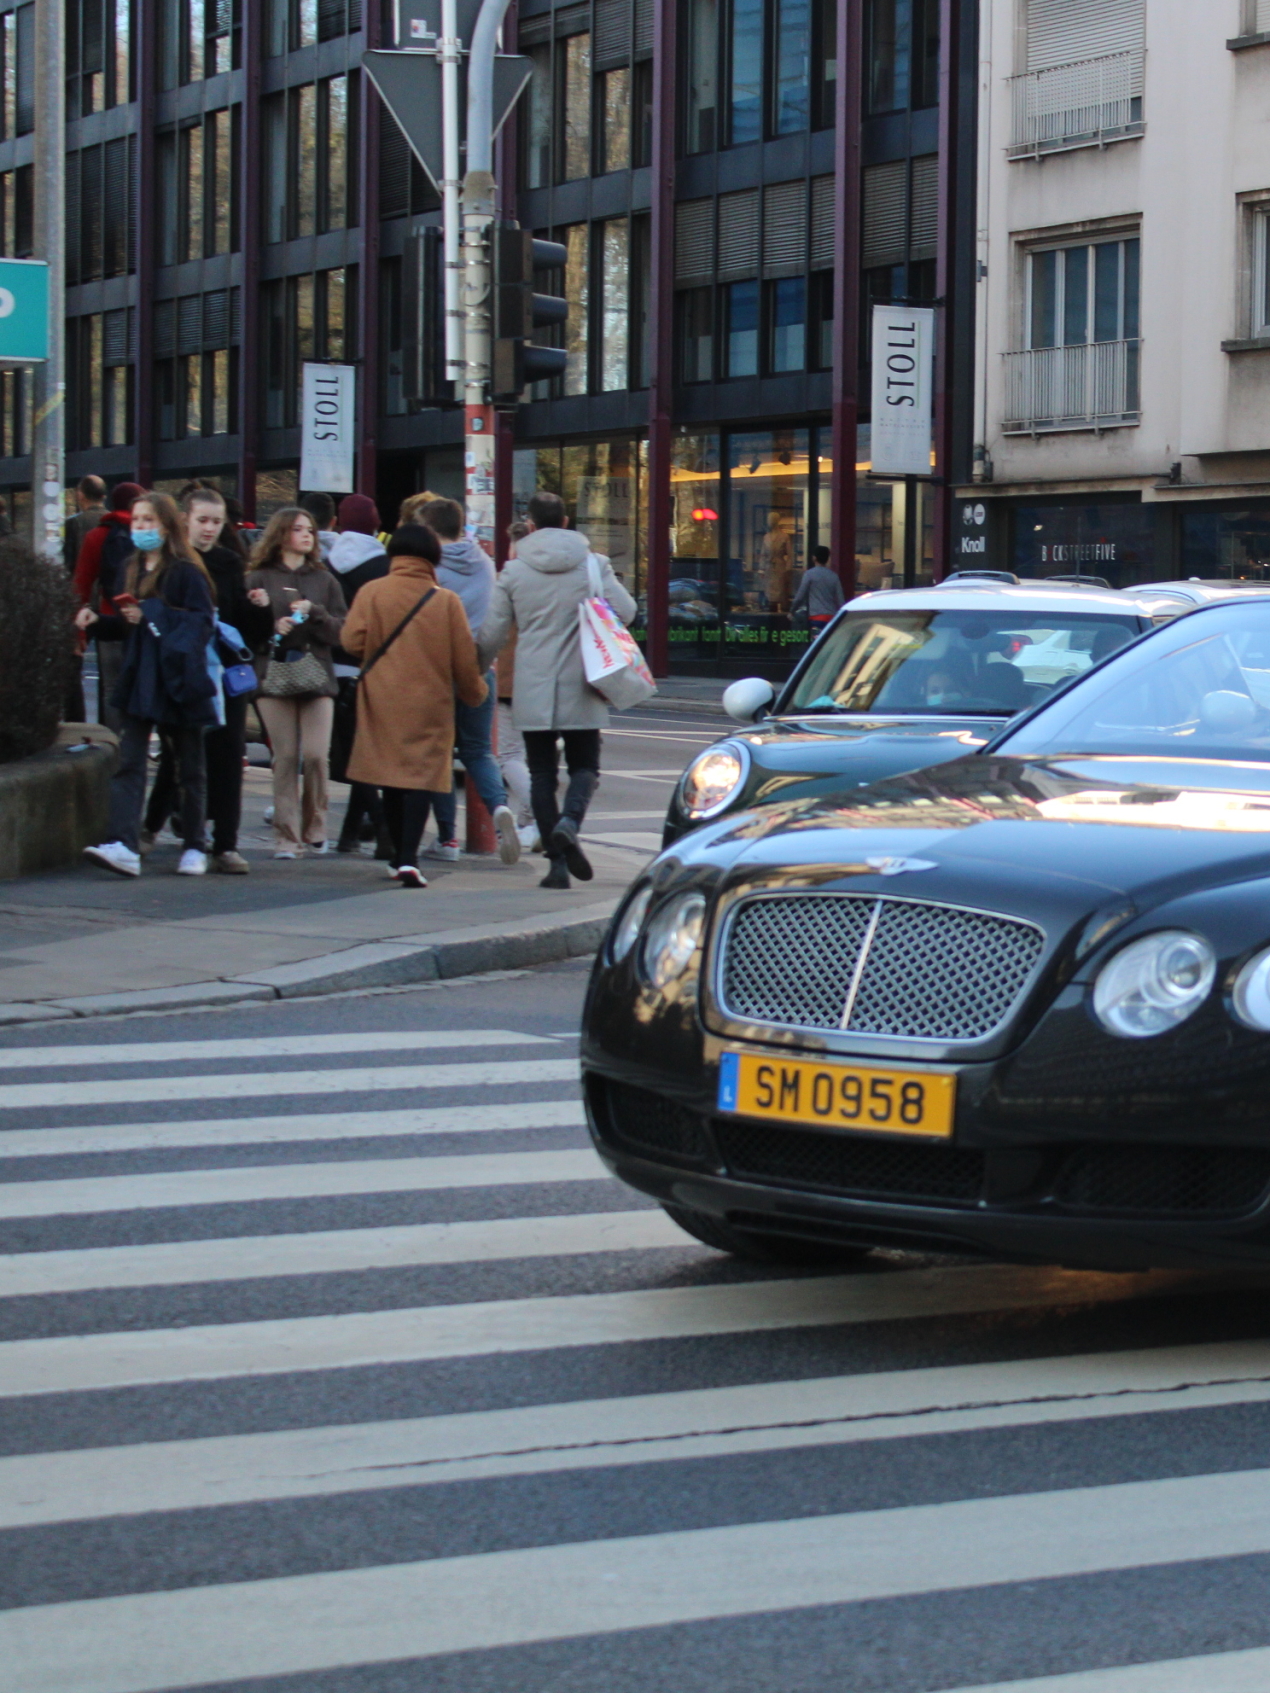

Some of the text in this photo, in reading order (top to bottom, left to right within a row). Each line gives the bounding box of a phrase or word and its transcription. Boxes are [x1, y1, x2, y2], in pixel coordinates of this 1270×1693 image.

[886, 322, 915, 406] STOLL
[313, 376, 338, 441] STOLL
[961, 536, 986, 553] Knoll
[756, 1065, 925, 1124] SM 0958
